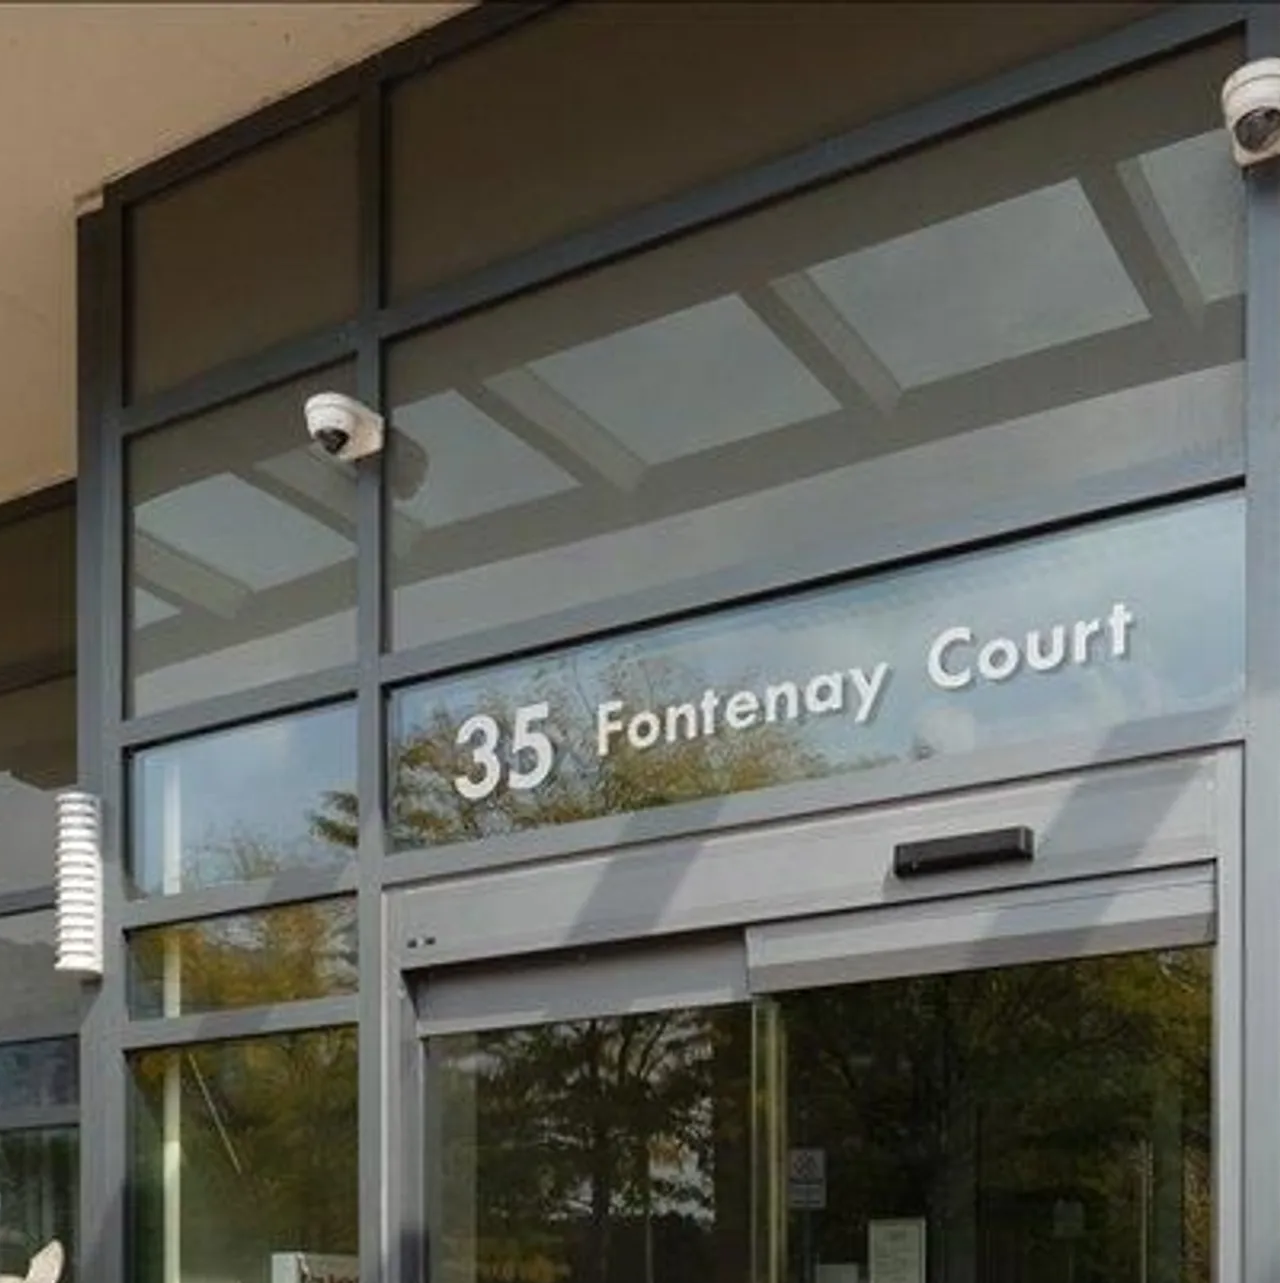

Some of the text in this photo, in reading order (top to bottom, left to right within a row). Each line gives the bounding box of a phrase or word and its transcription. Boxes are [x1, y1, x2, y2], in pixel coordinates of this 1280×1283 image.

[453, 603, 1138, 801] 35 Fontenay Court
